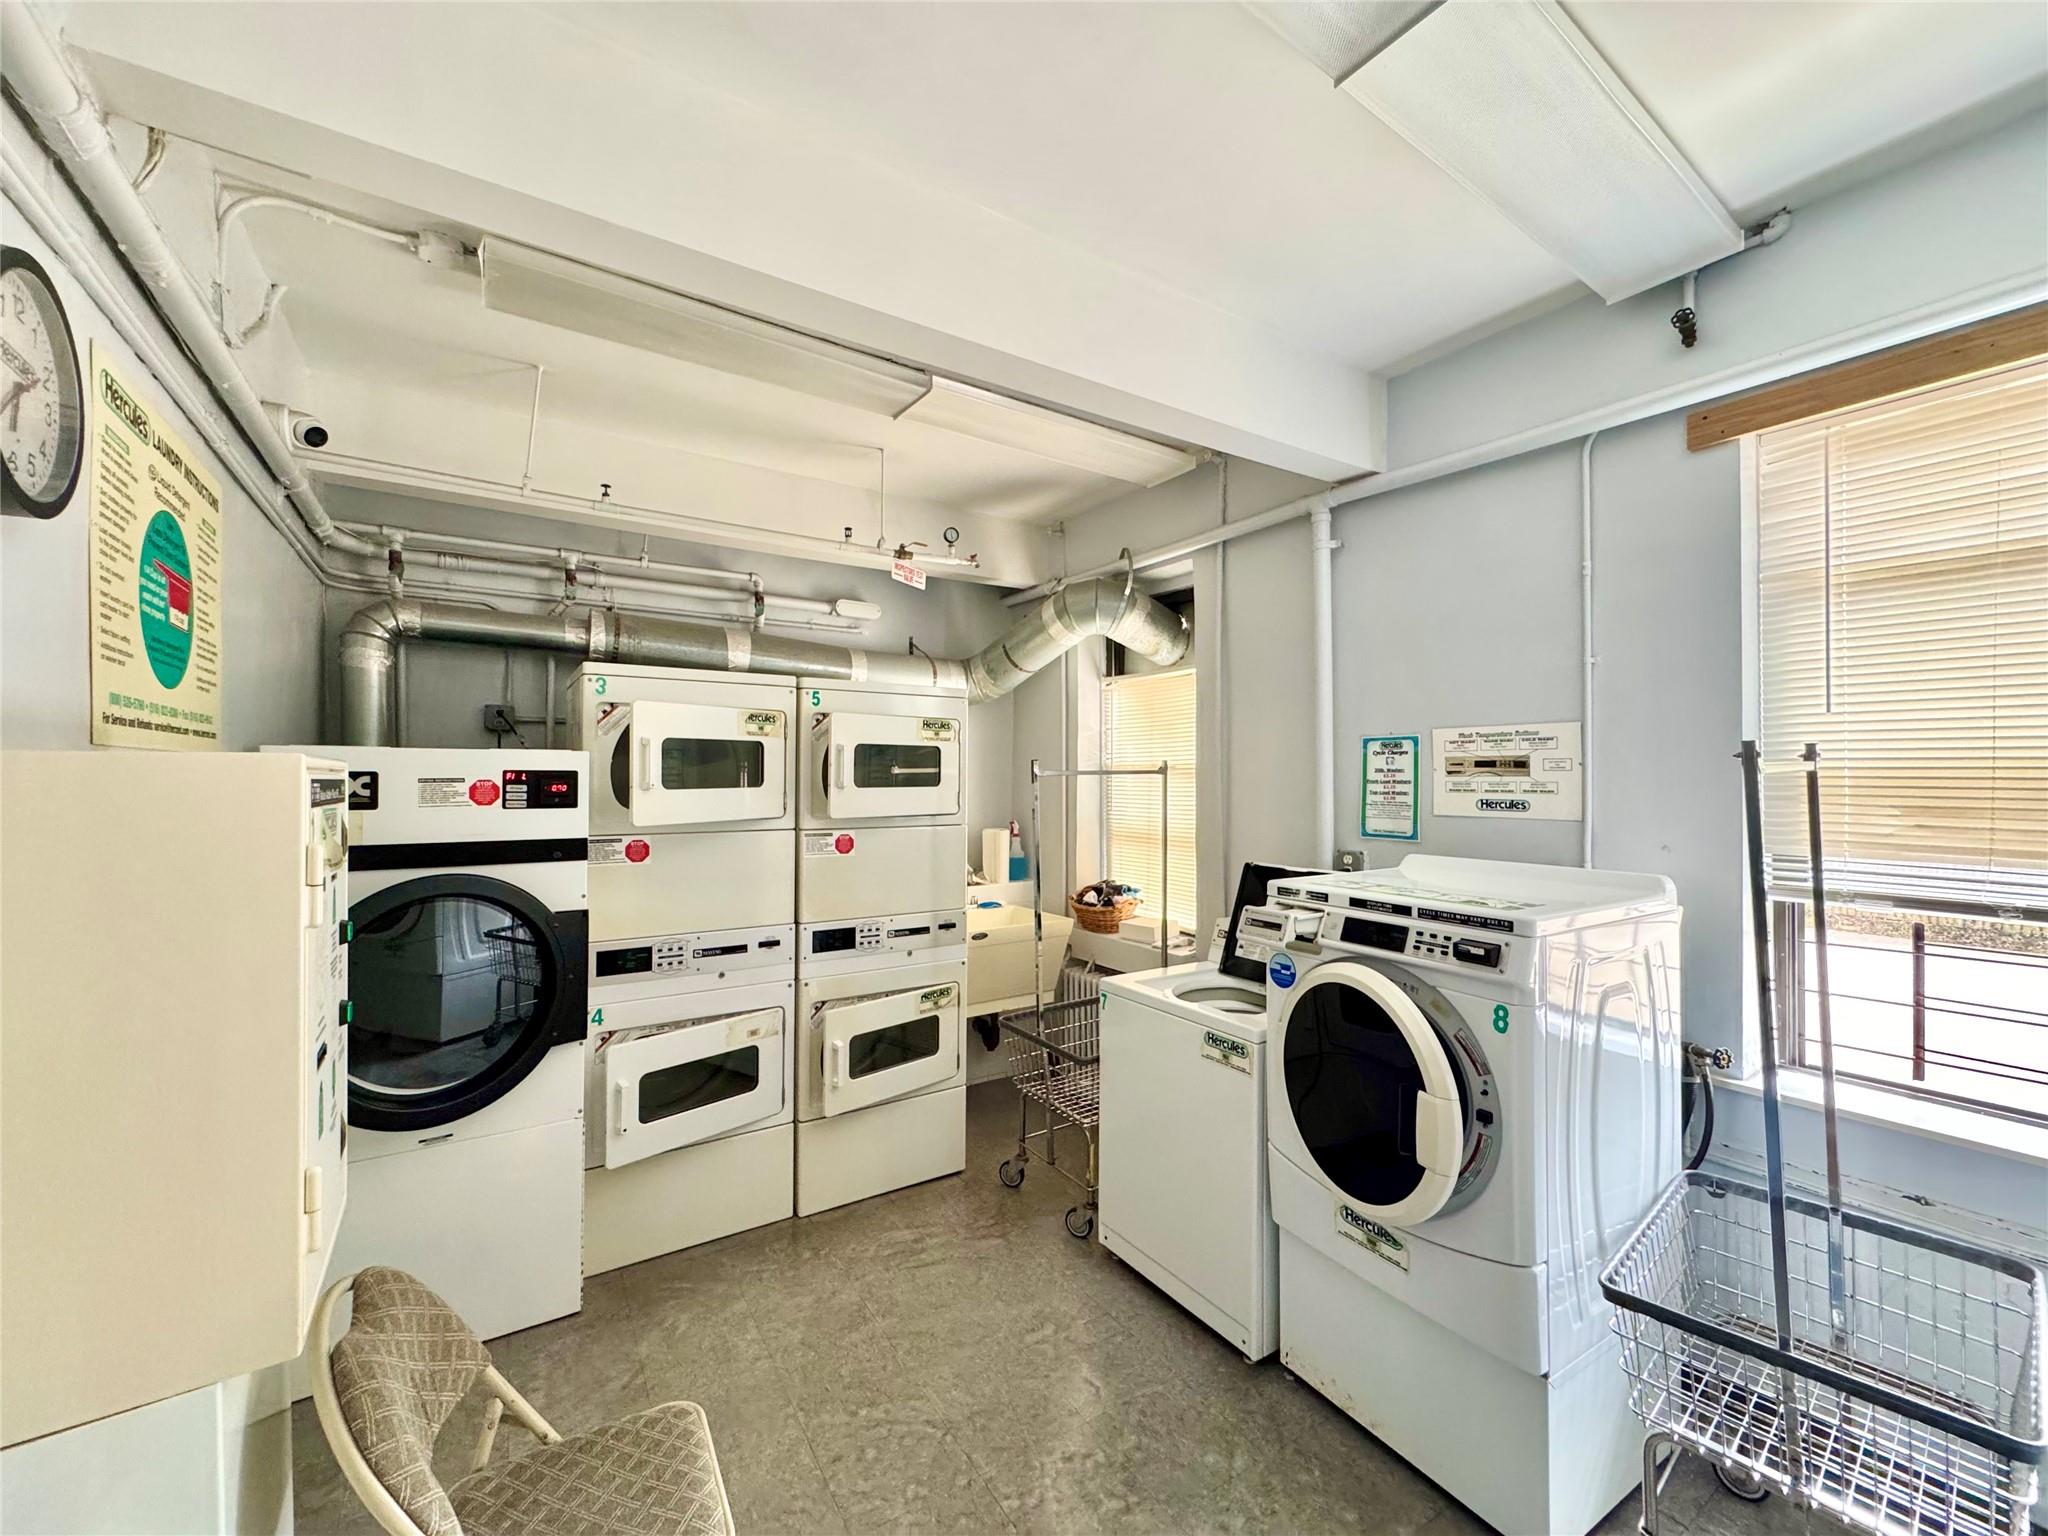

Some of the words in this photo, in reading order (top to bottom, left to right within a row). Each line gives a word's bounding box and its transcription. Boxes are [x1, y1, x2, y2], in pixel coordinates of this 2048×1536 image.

[42, 366, 52, 392] 2
[45, 402, 52, 427] 3
[39, 440, 46, 461] 4
[105, 372, 148, 440] Hercules
[153, 430, 183, 474] LAUNDRY
[184, 462, 219, 513] INSTRUCTIONS
[27, 453, 36, 478] 5
[595, 676, 607, 695] 3
[812, 690, 821, 706] 5
[923, 720, 951, 730] Hercules
[1480, 799, 1527, 810] Hercules
[1419, 908, 1435, 916] CYCLE
[1437, 910, 1454, 918] TIMES
[1470, 916, 1485, 924] VARY
[1101, 991, 1108, 1010] 7
[591, 1008, 604, 1026] 4
[1493, 1004, 1509, 1034] 8
[1207, 1031, 1246, 1056] Hercules
